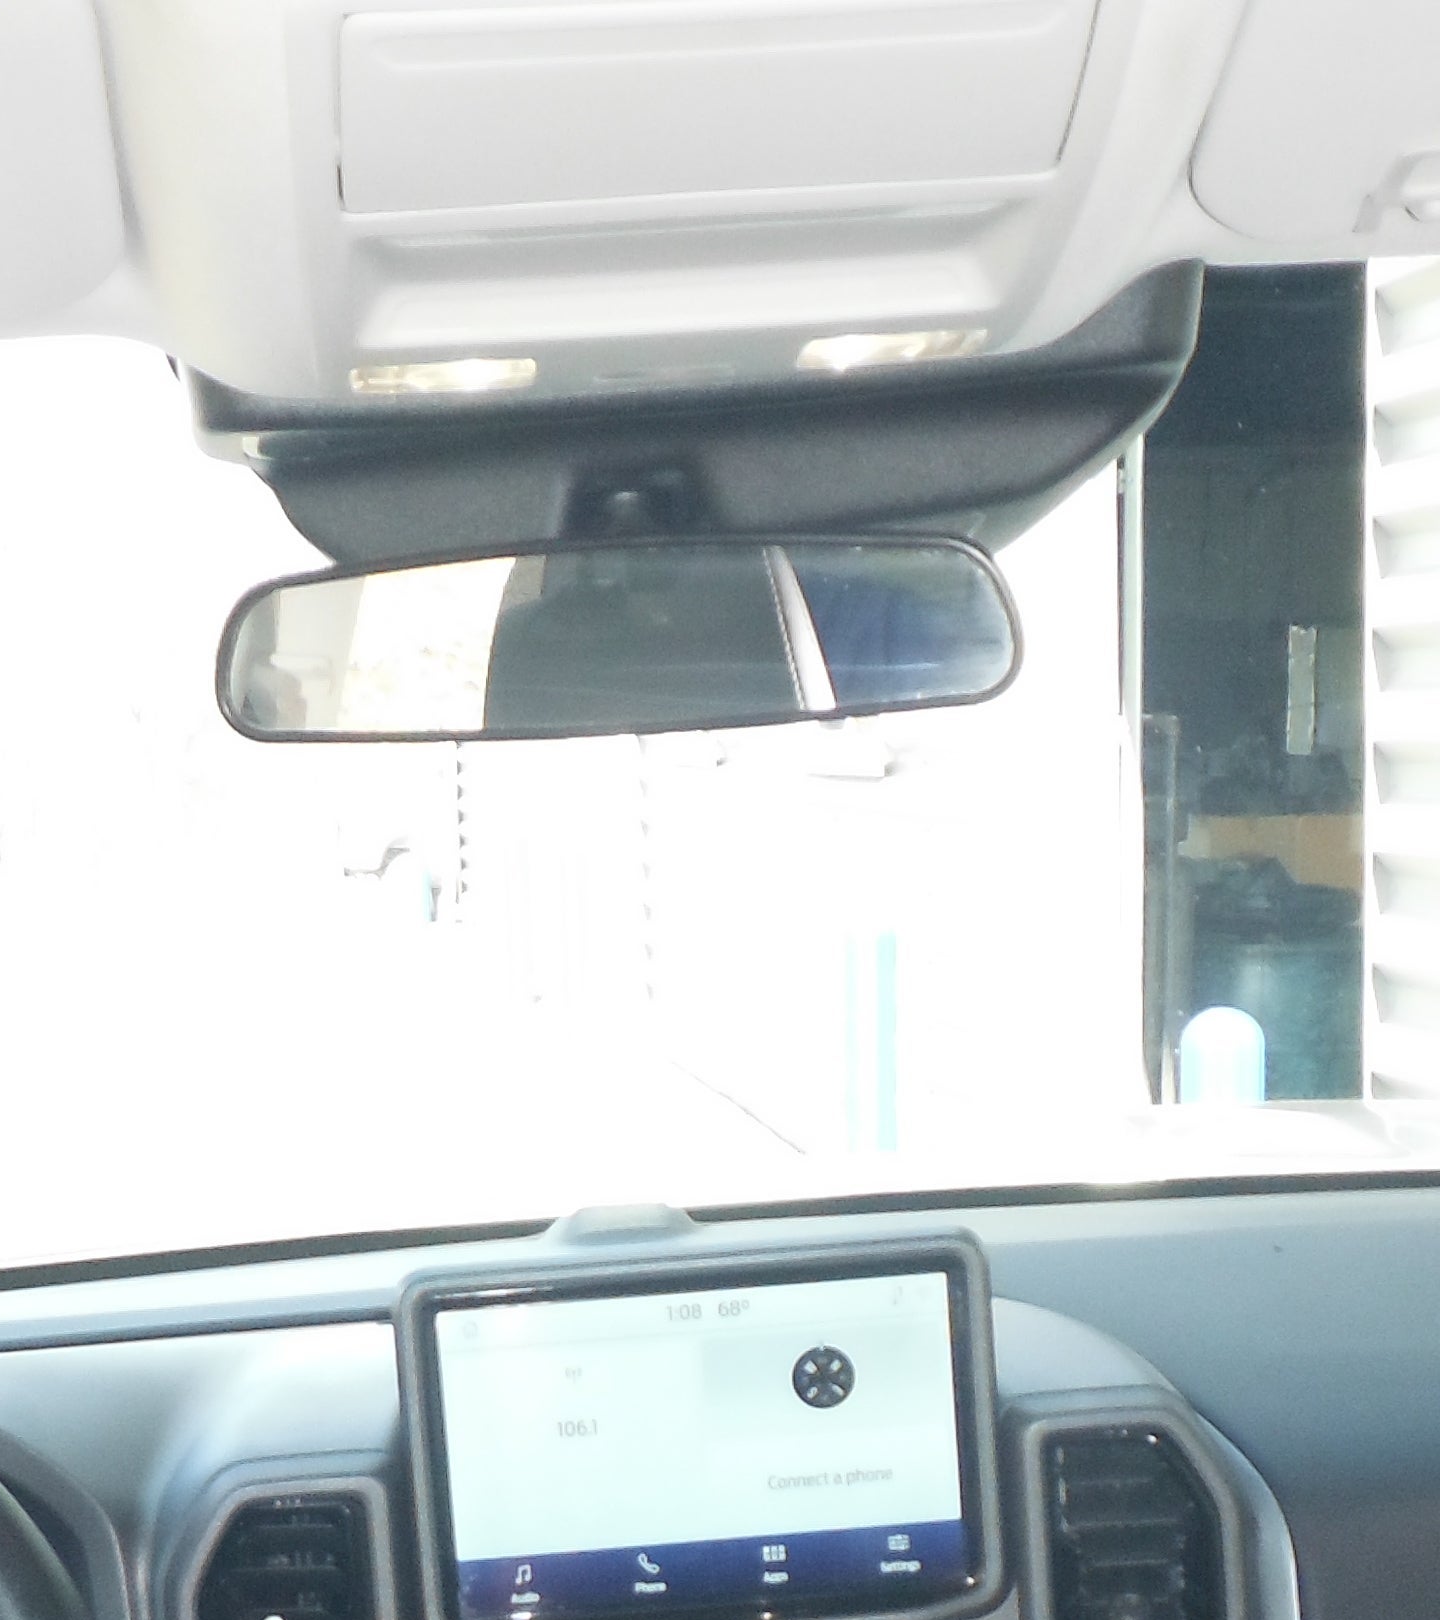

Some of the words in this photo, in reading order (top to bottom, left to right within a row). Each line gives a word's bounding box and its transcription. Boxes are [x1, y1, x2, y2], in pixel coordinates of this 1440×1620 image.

[665, 1303, 703, 1322] 1:08
[556, 1419, 599, 1438] 106.1
[767, 1472, 830, 1491] Connect
[833, 1474, 844, 1486] a
[846, 1467, 894, 1487] phone
[634, 1581, 668, 1595] Phone
